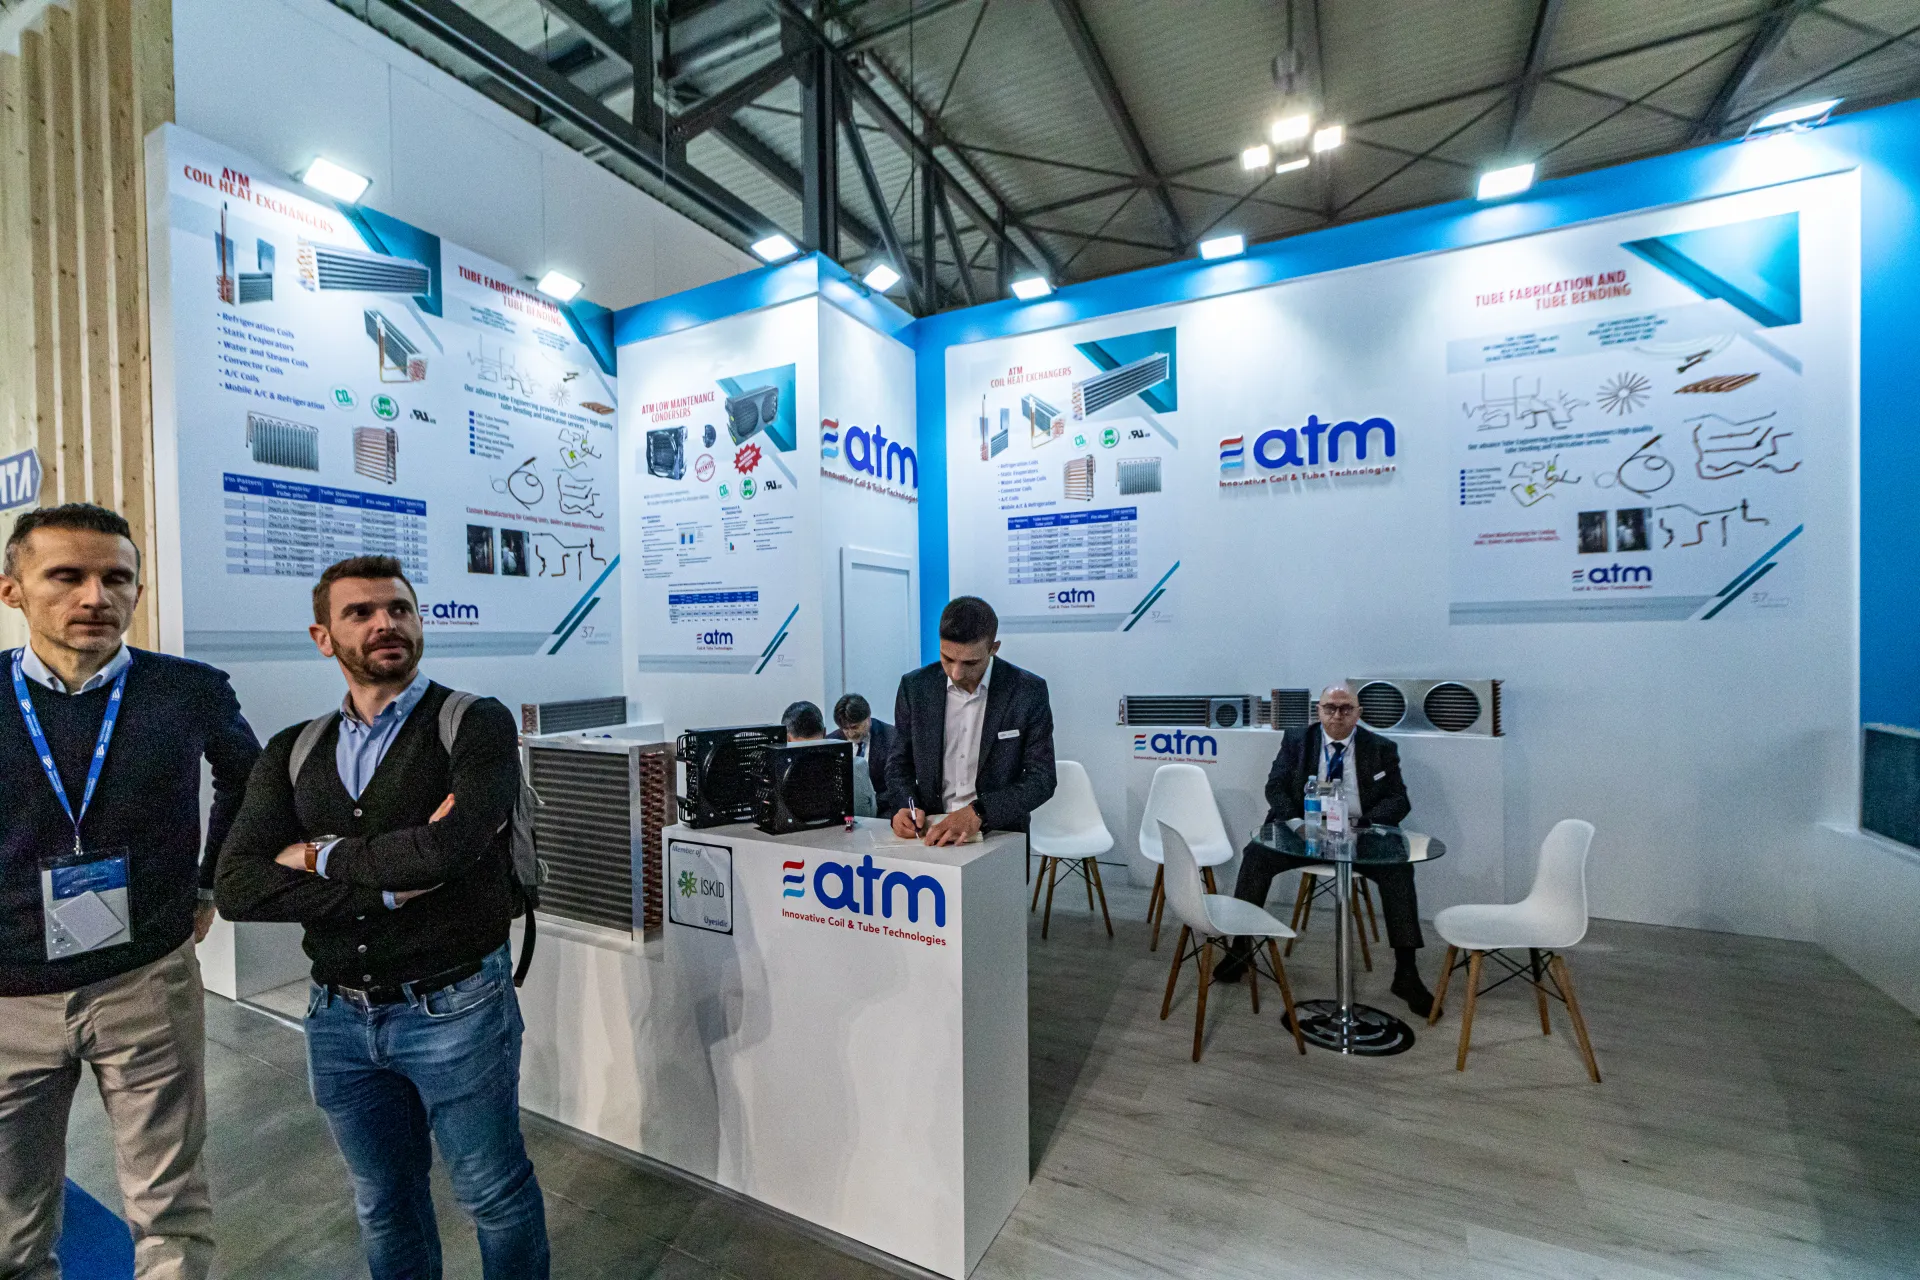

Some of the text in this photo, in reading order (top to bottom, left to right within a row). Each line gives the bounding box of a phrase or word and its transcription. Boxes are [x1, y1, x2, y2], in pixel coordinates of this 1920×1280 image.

[183, 164, 215, 189] COIL
[219, 178, 251, 202] HEAT
[222, 166, 250, 187] ATM
[458, 265, 482, 285] TUBE
[1475, 269, 1627, 308] TUBE FABRICATION AND
[1535, 283, 1632, 311] TUBE BENDING
[502, 295, 523, 312] TUBE
[222, 312, 295, 339] Refrigeration Coils
[223, 326, 294, 352] Static Evaporators
[223, 340, 247, 353] Water
[249, 347, 264, 357] and
[291, 358, 309, 368] Coils
[223, 354, 284, 375] Convector Coils
[224, 368, 259, 383] A/C Coils
[990, 366, 1072, 389] COIL HEAT EXCHANGERS
[1008, 366, 1023, 376] ATM
[224, 381, 252, 395] Mobile
[277, 393, 326, 411] Refrigeration
[641, 391, 715, 415] ATM LOW MAINTENANCE
[1253, 414, 1396, 469] atm
[845, 424, 919, 489] atm
[866, 481, 872, 490] &
[1219, 465, 1397, 488] Innovative Coil & Tube Technologies
[1588, 563, 1653, 584] atm
[1057, 587, 1095, 603] atm
[432, 600, 479, 619] atm
[581, 626, 595, 639] 37
[703, 628, 733, 645] atm
[1150, 729, 1218, 756] atm
[672, 845, 702, 857] Member of
[813, 854, 946, 928] atm
[781, 908, 947, 947] Innovative Coil & Tube Technologies
